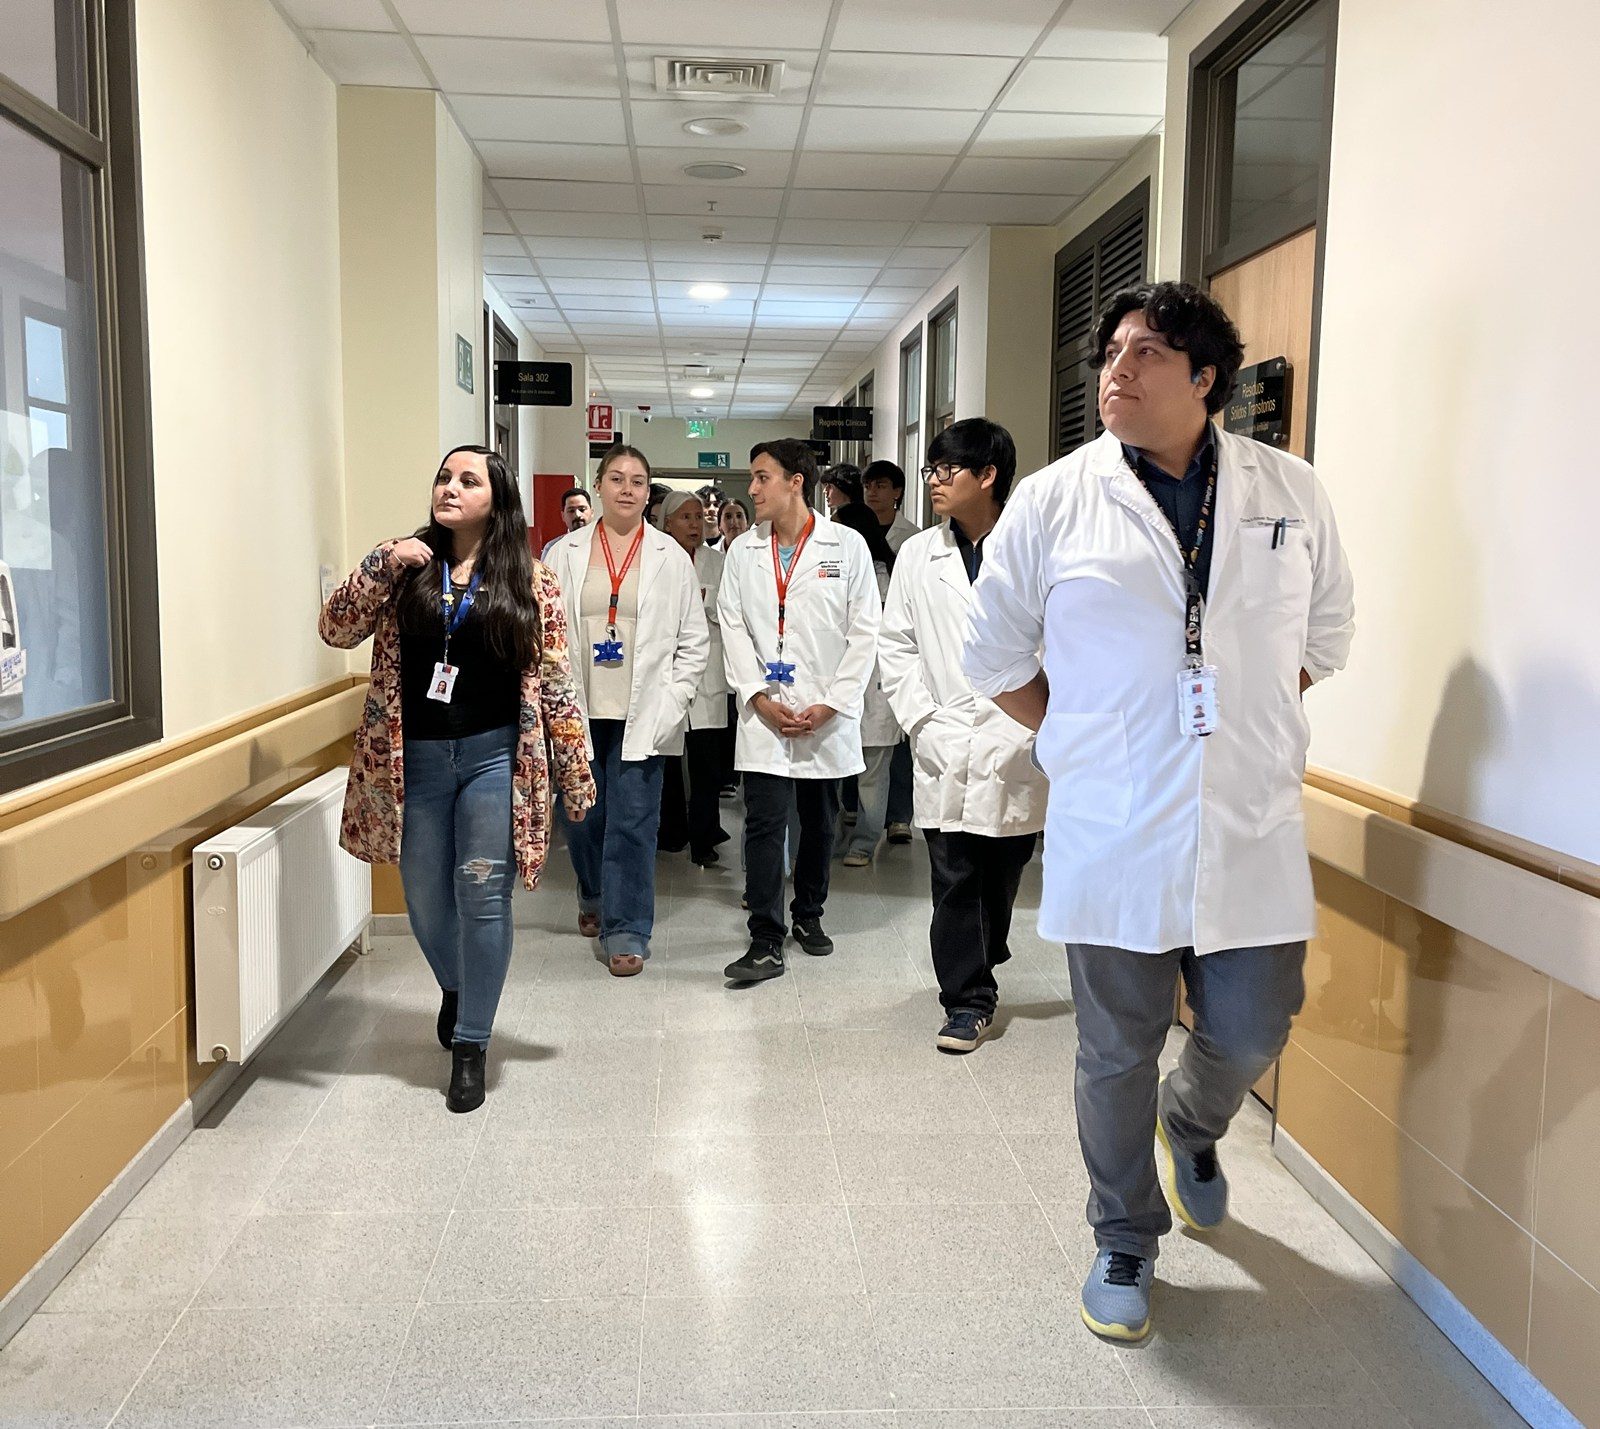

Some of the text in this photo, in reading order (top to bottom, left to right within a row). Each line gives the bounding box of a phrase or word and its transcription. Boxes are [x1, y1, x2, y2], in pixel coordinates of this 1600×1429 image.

[518, 372, 549, 383] Sala 302
[1242, 381, 1265, 399] Residuos
[819, 418, 844, 427] Registros
